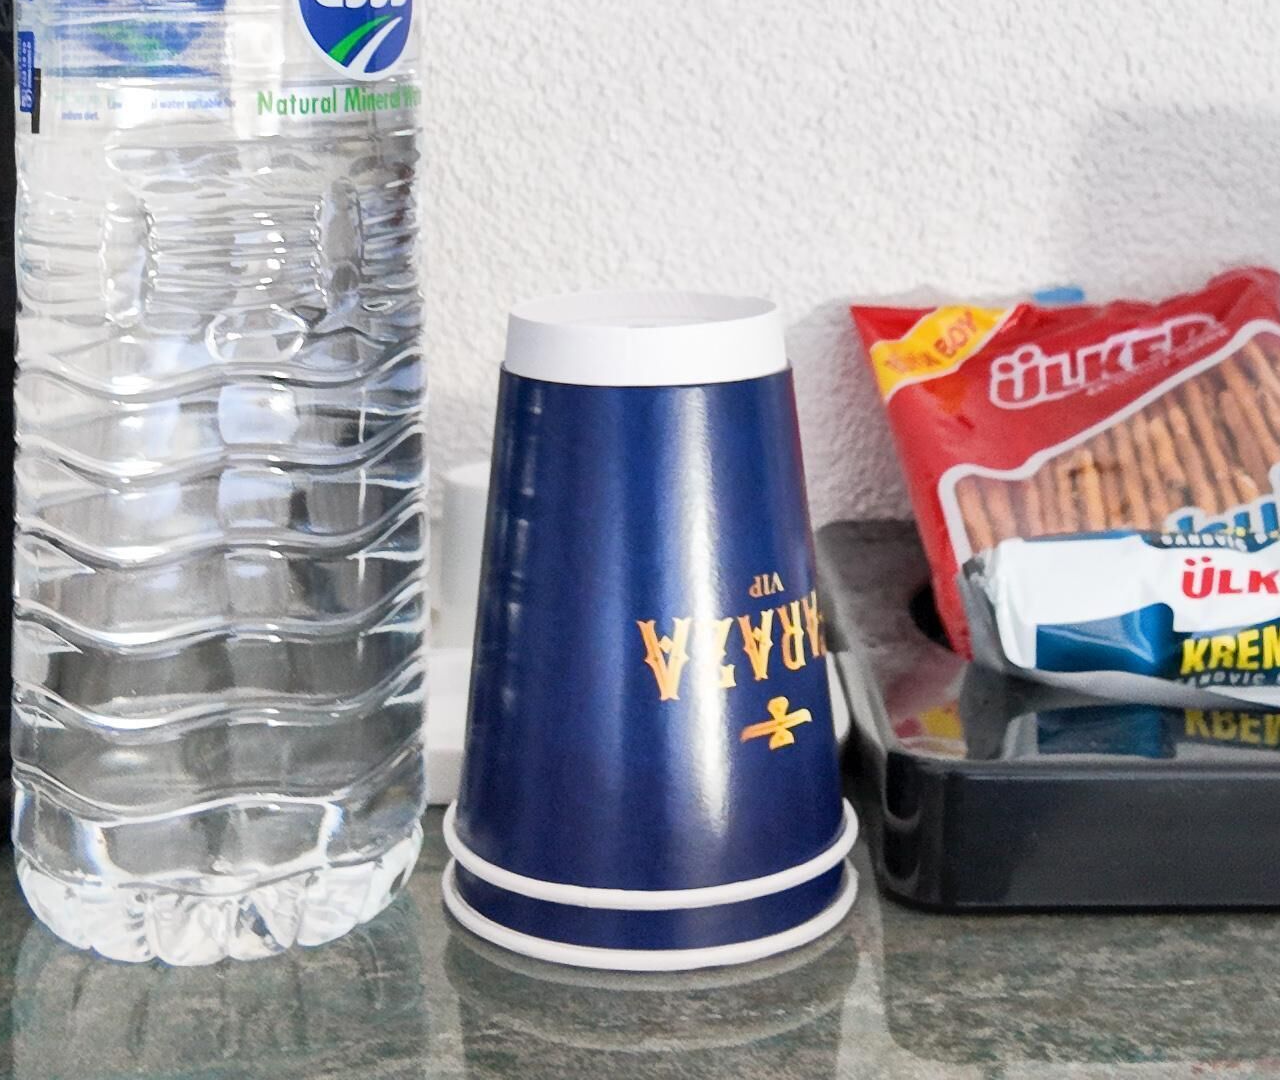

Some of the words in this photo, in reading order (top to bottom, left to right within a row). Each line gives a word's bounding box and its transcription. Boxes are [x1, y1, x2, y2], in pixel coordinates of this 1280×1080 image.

[256, 87, 337, 116] Natural
[748, 571, 786, 599] VIP
[636, 588, 827, 701] ARAZA
